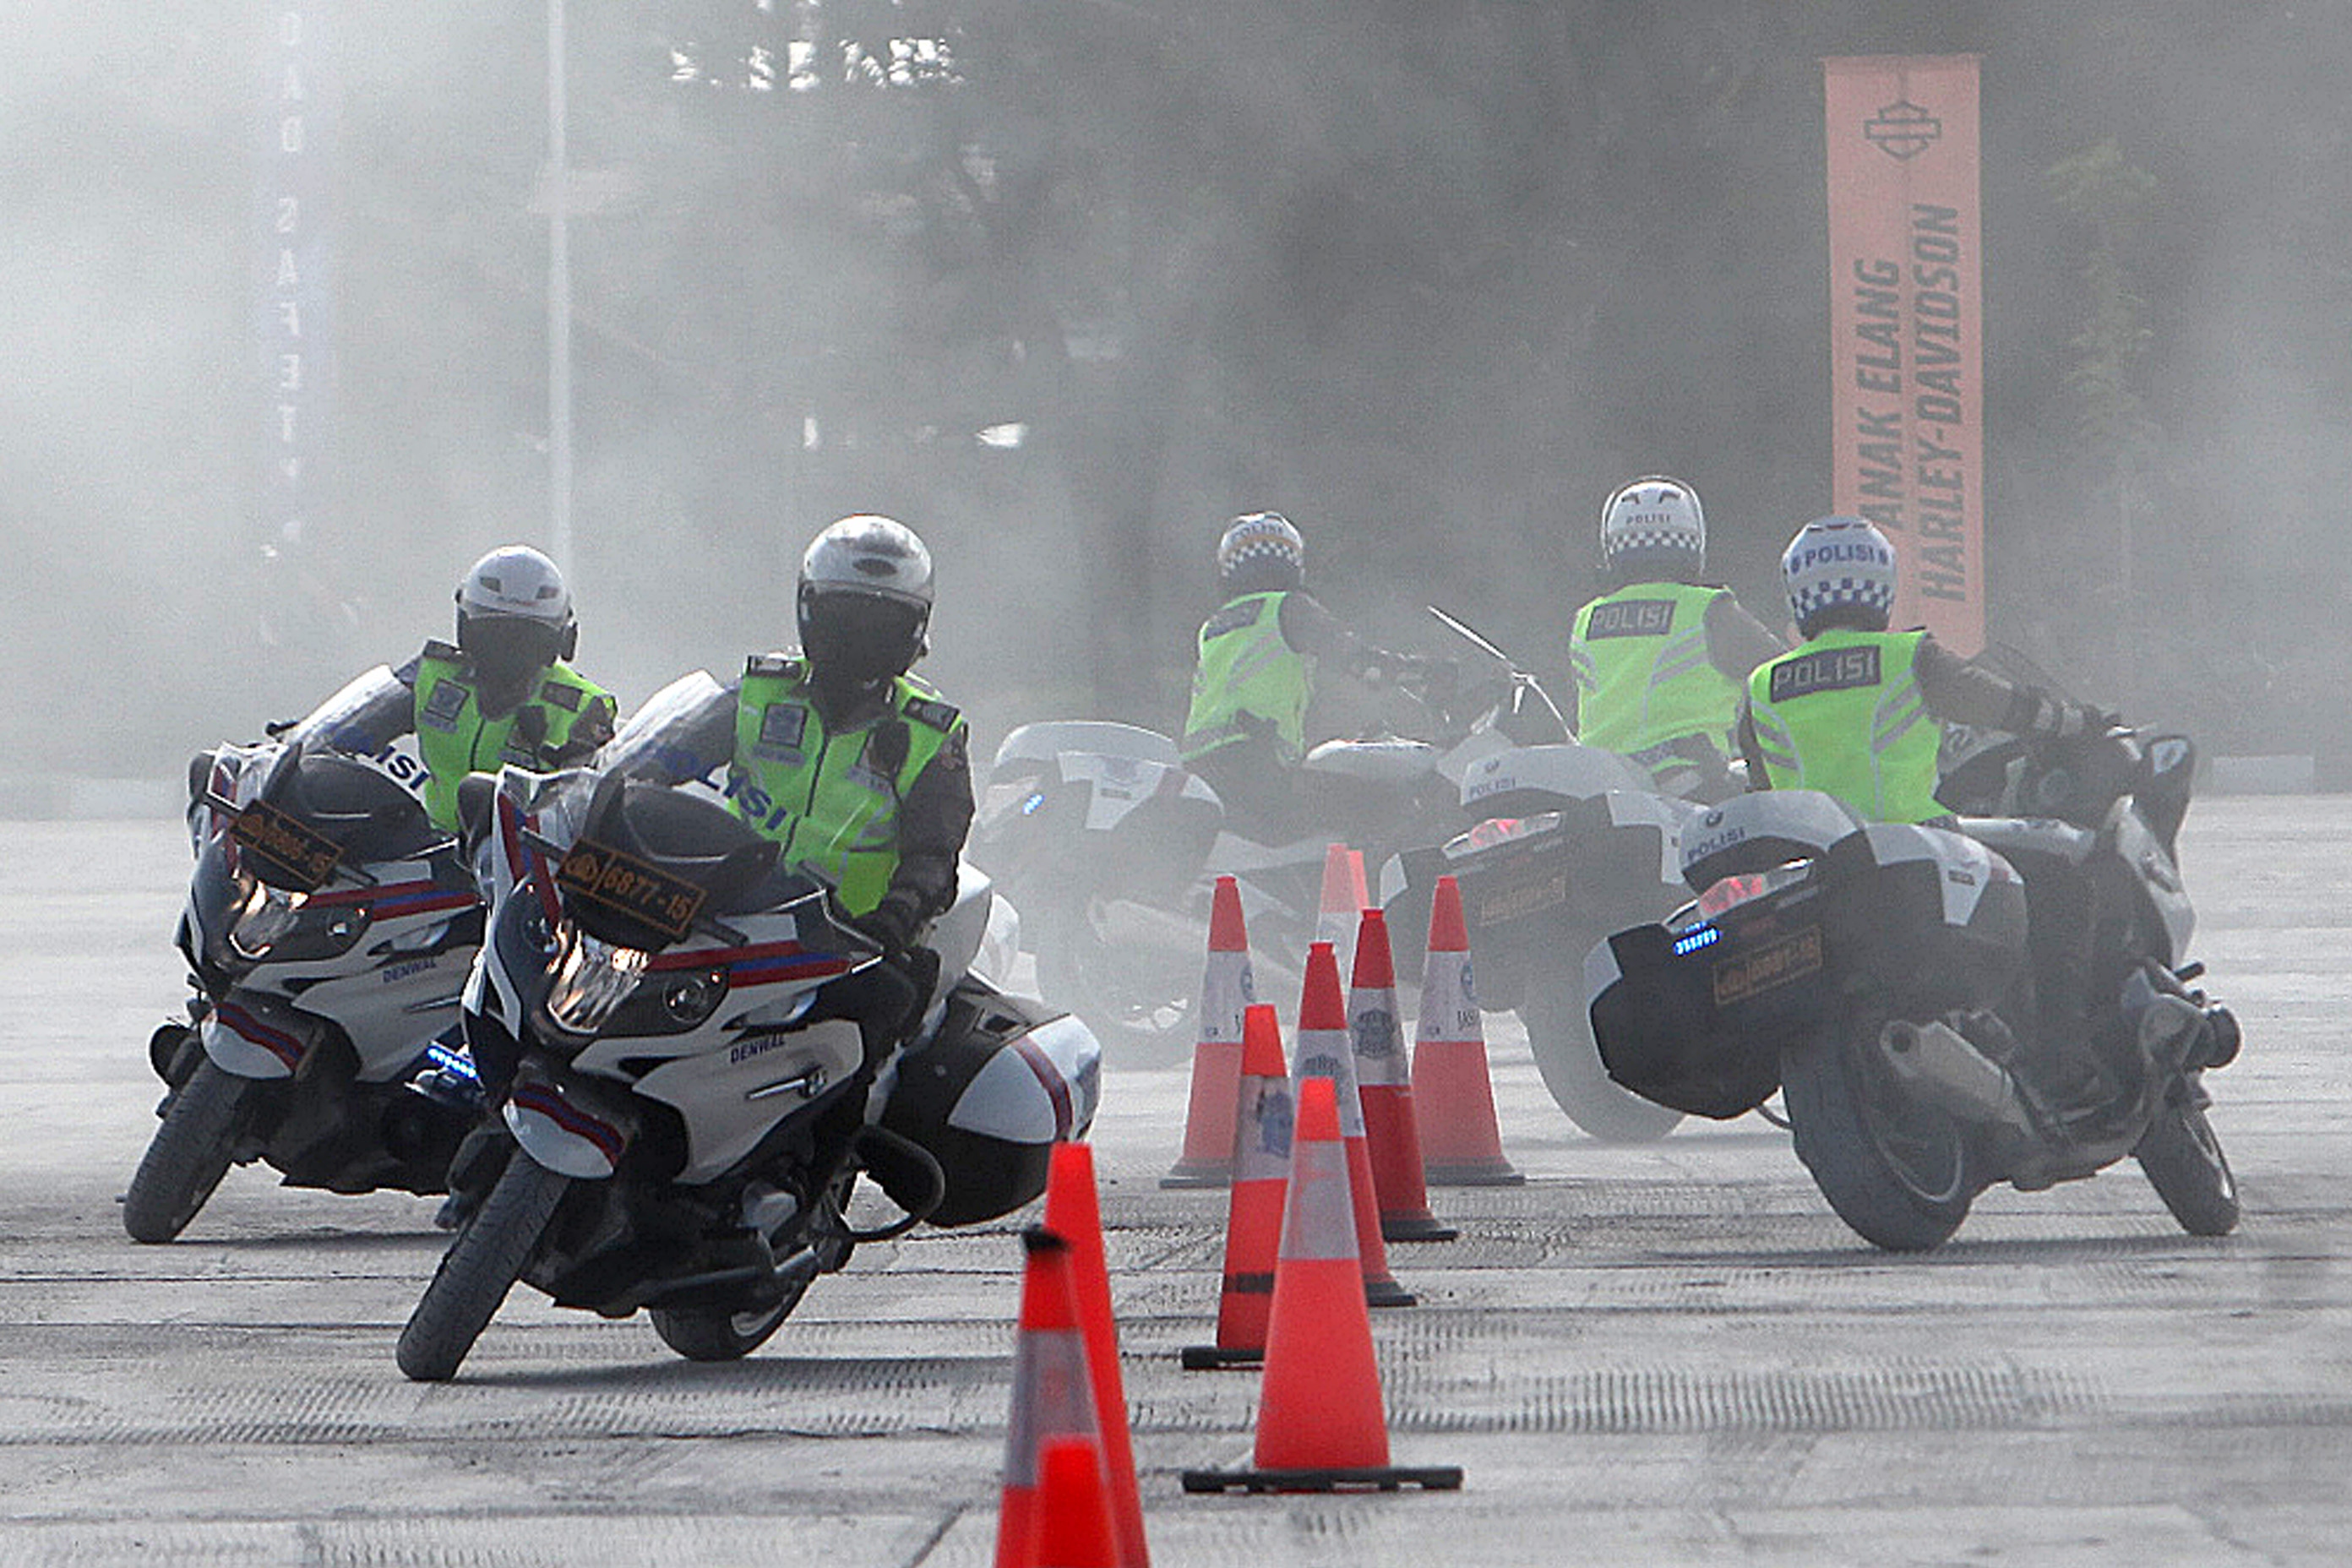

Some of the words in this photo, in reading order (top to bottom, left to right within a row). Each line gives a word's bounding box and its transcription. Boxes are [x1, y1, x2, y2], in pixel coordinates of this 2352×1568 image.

[1854, 259, 1901, 394] ELANG
[1912, 203, 1967, 602] HARLEY-DAVIDSON
[1857, 406, 1904, 531] ANAK
[1626, 512, 1670, 525] POLISI
[1805, 544, 1875, 568] POLISI
[1591, 604, 1670, 630] POLISI
[1773, 651, 1874, 692] POLISI
[1469, 776, 1516, 798] POLISI
[1687, 825, 1746, 861] POLISI
[603, 866, 693, 921] 6877-15
